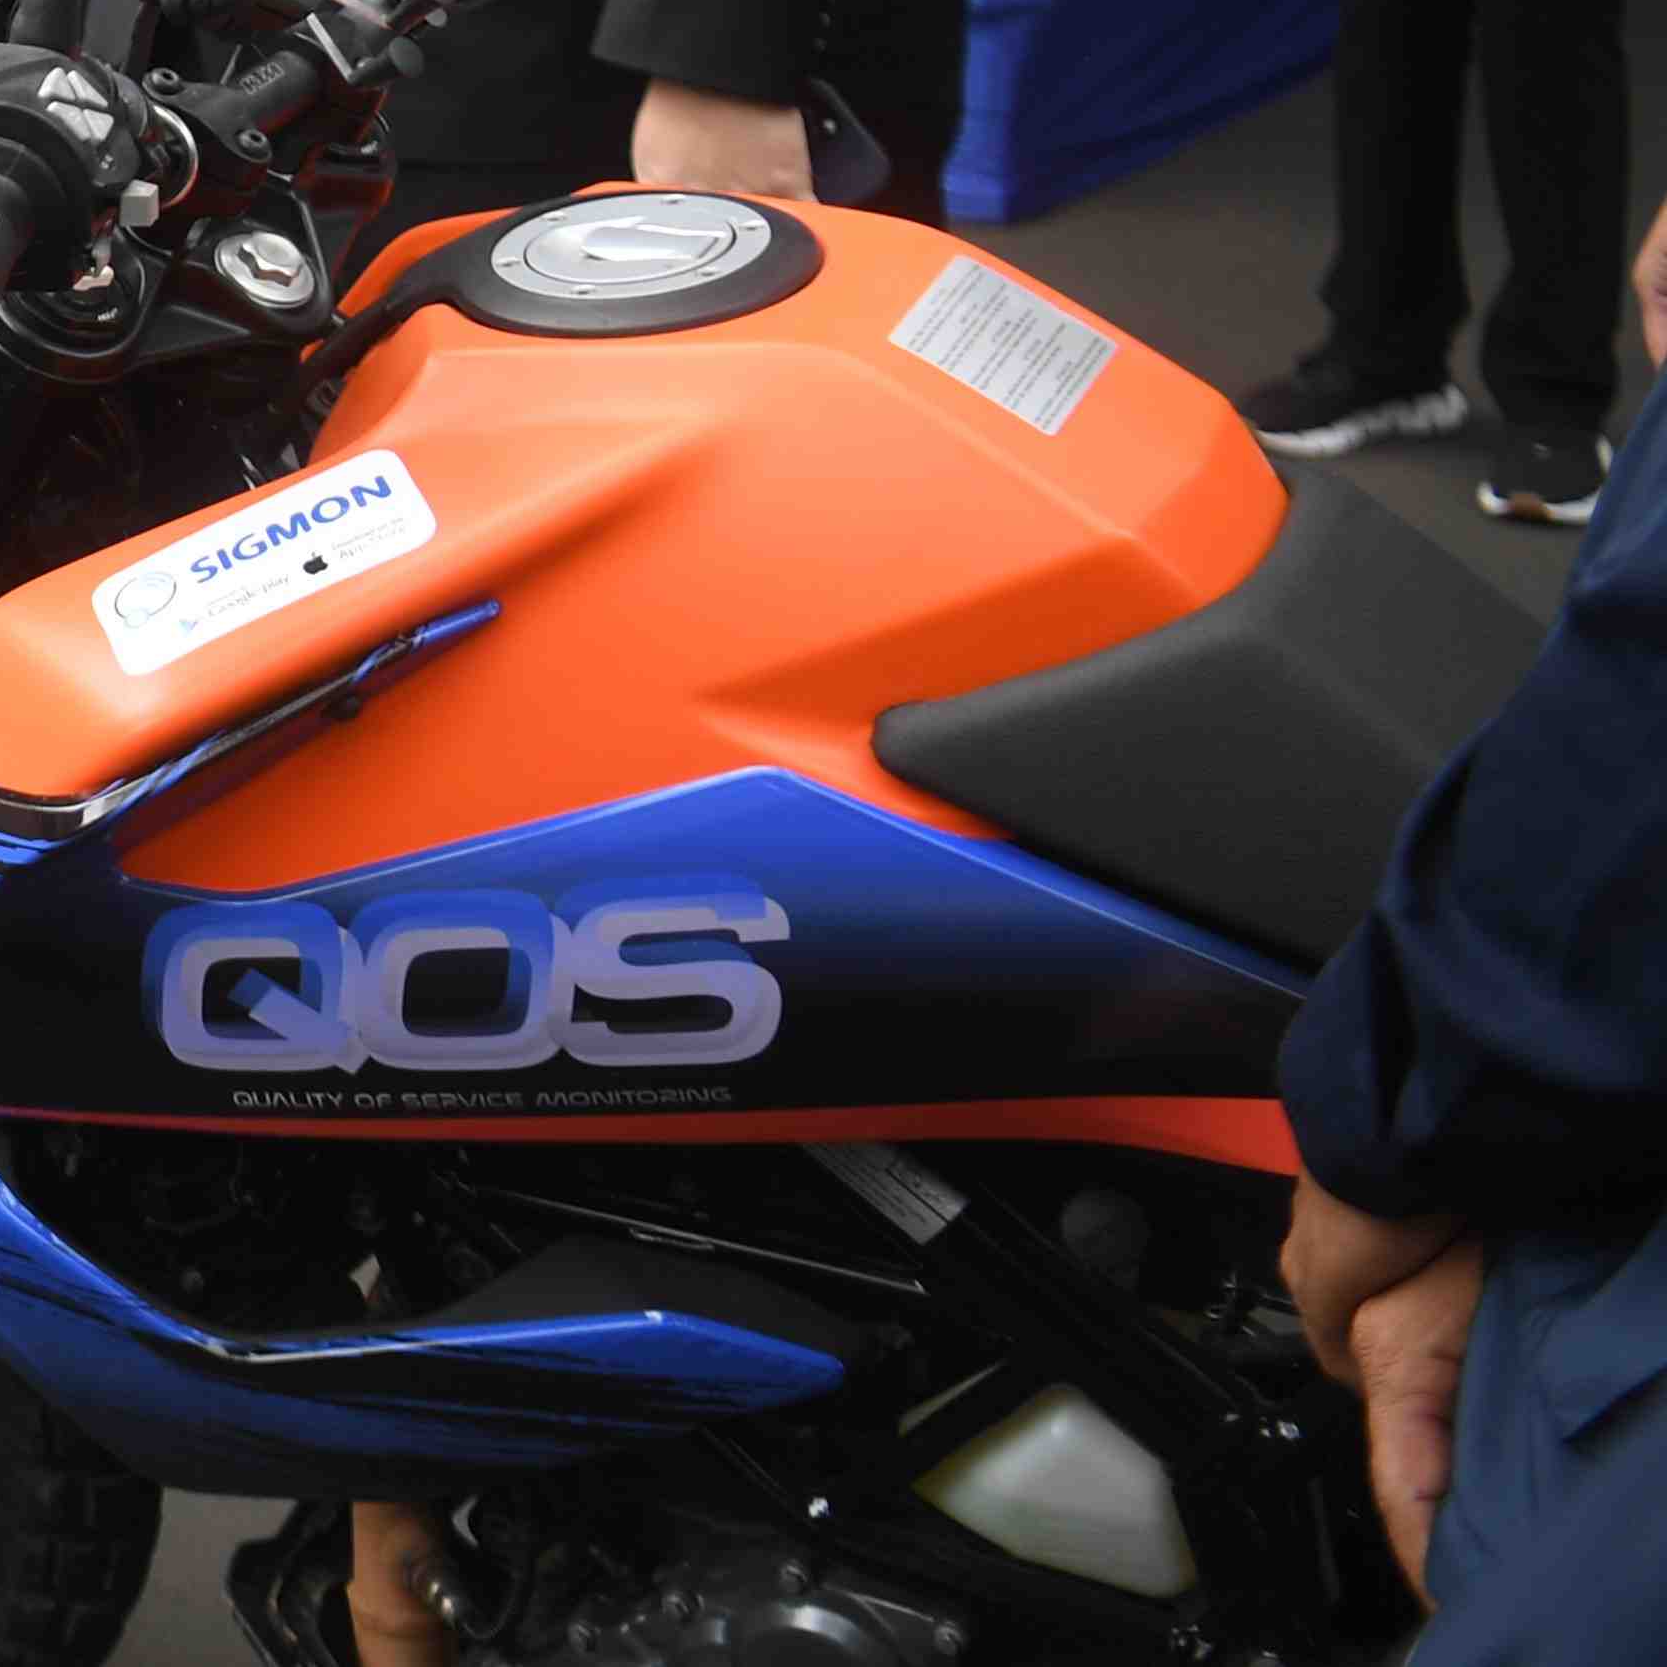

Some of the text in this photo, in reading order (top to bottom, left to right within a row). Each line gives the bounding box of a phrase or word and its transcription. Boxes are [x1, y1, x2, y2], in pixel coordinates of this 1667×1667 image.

[190, 475, 392, 583] SIGMON
[144, 875, 790, 1075] QOS
[232, 1085, 733, 1110] QUALITY OF SERVICE MONITORING
